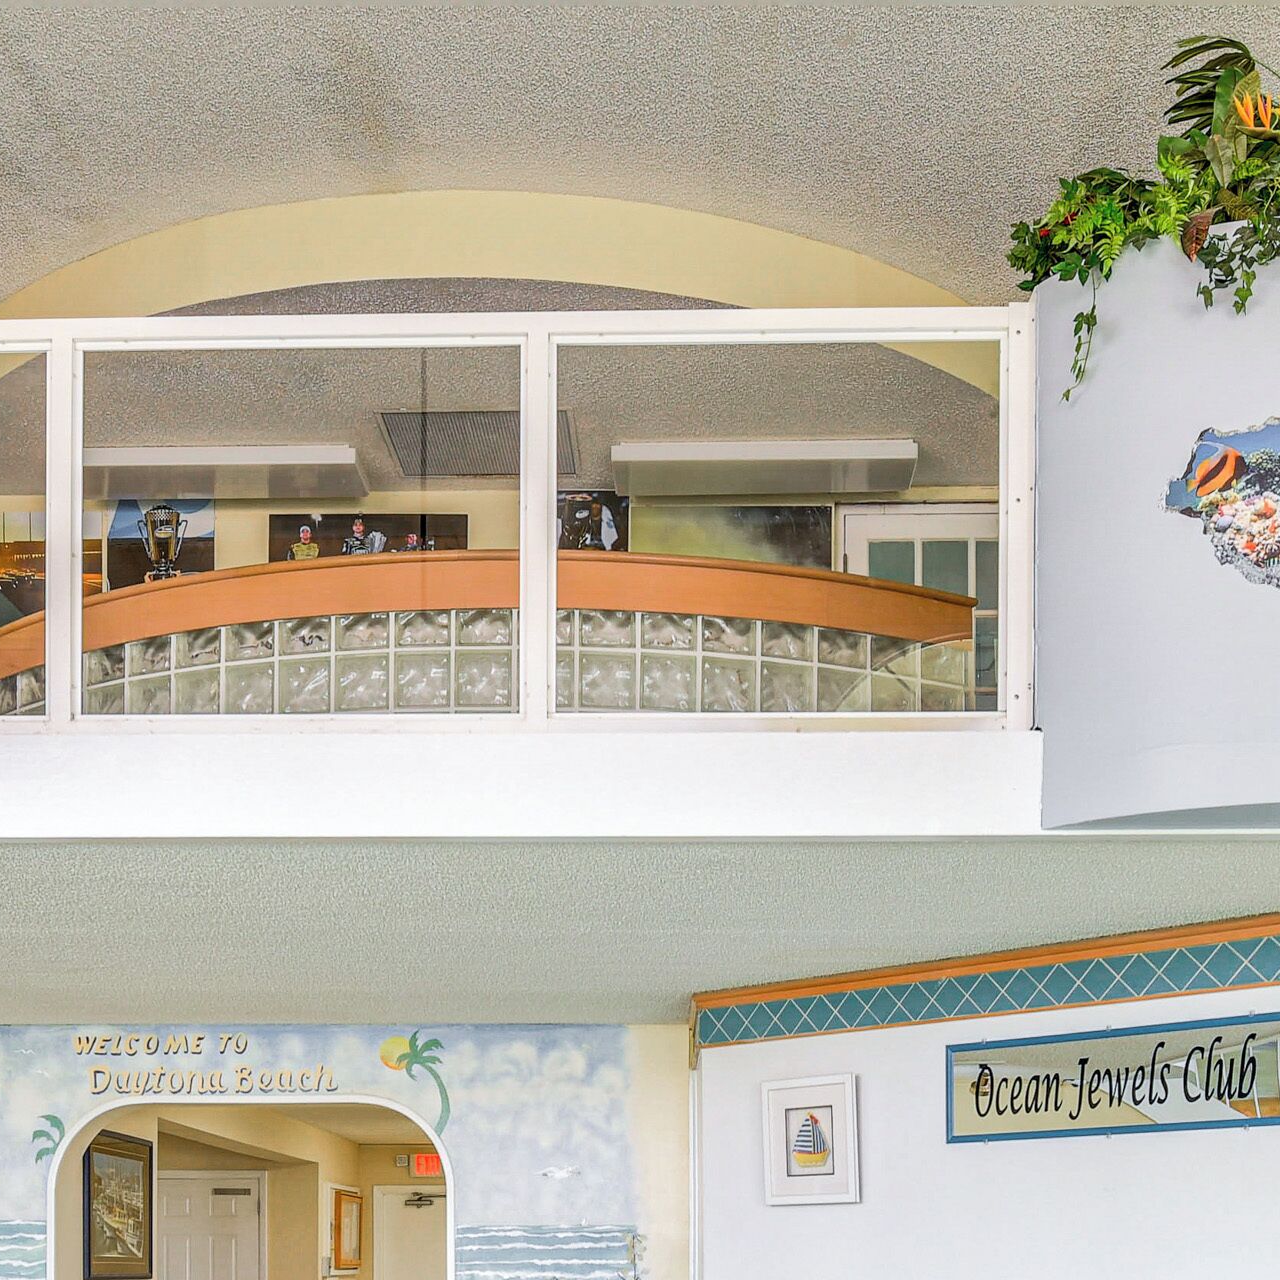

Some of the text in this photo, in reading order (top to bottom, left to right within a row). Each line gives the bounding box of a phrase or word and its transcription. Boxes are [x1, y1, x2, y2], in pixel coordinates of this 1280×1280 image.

[74, 1031, 249, 1056] WELCOME TO
[89, 1063, 339, 1096] Daytona Beach
[974, 1032, 1258, 1120] Ocean Jewels Club
